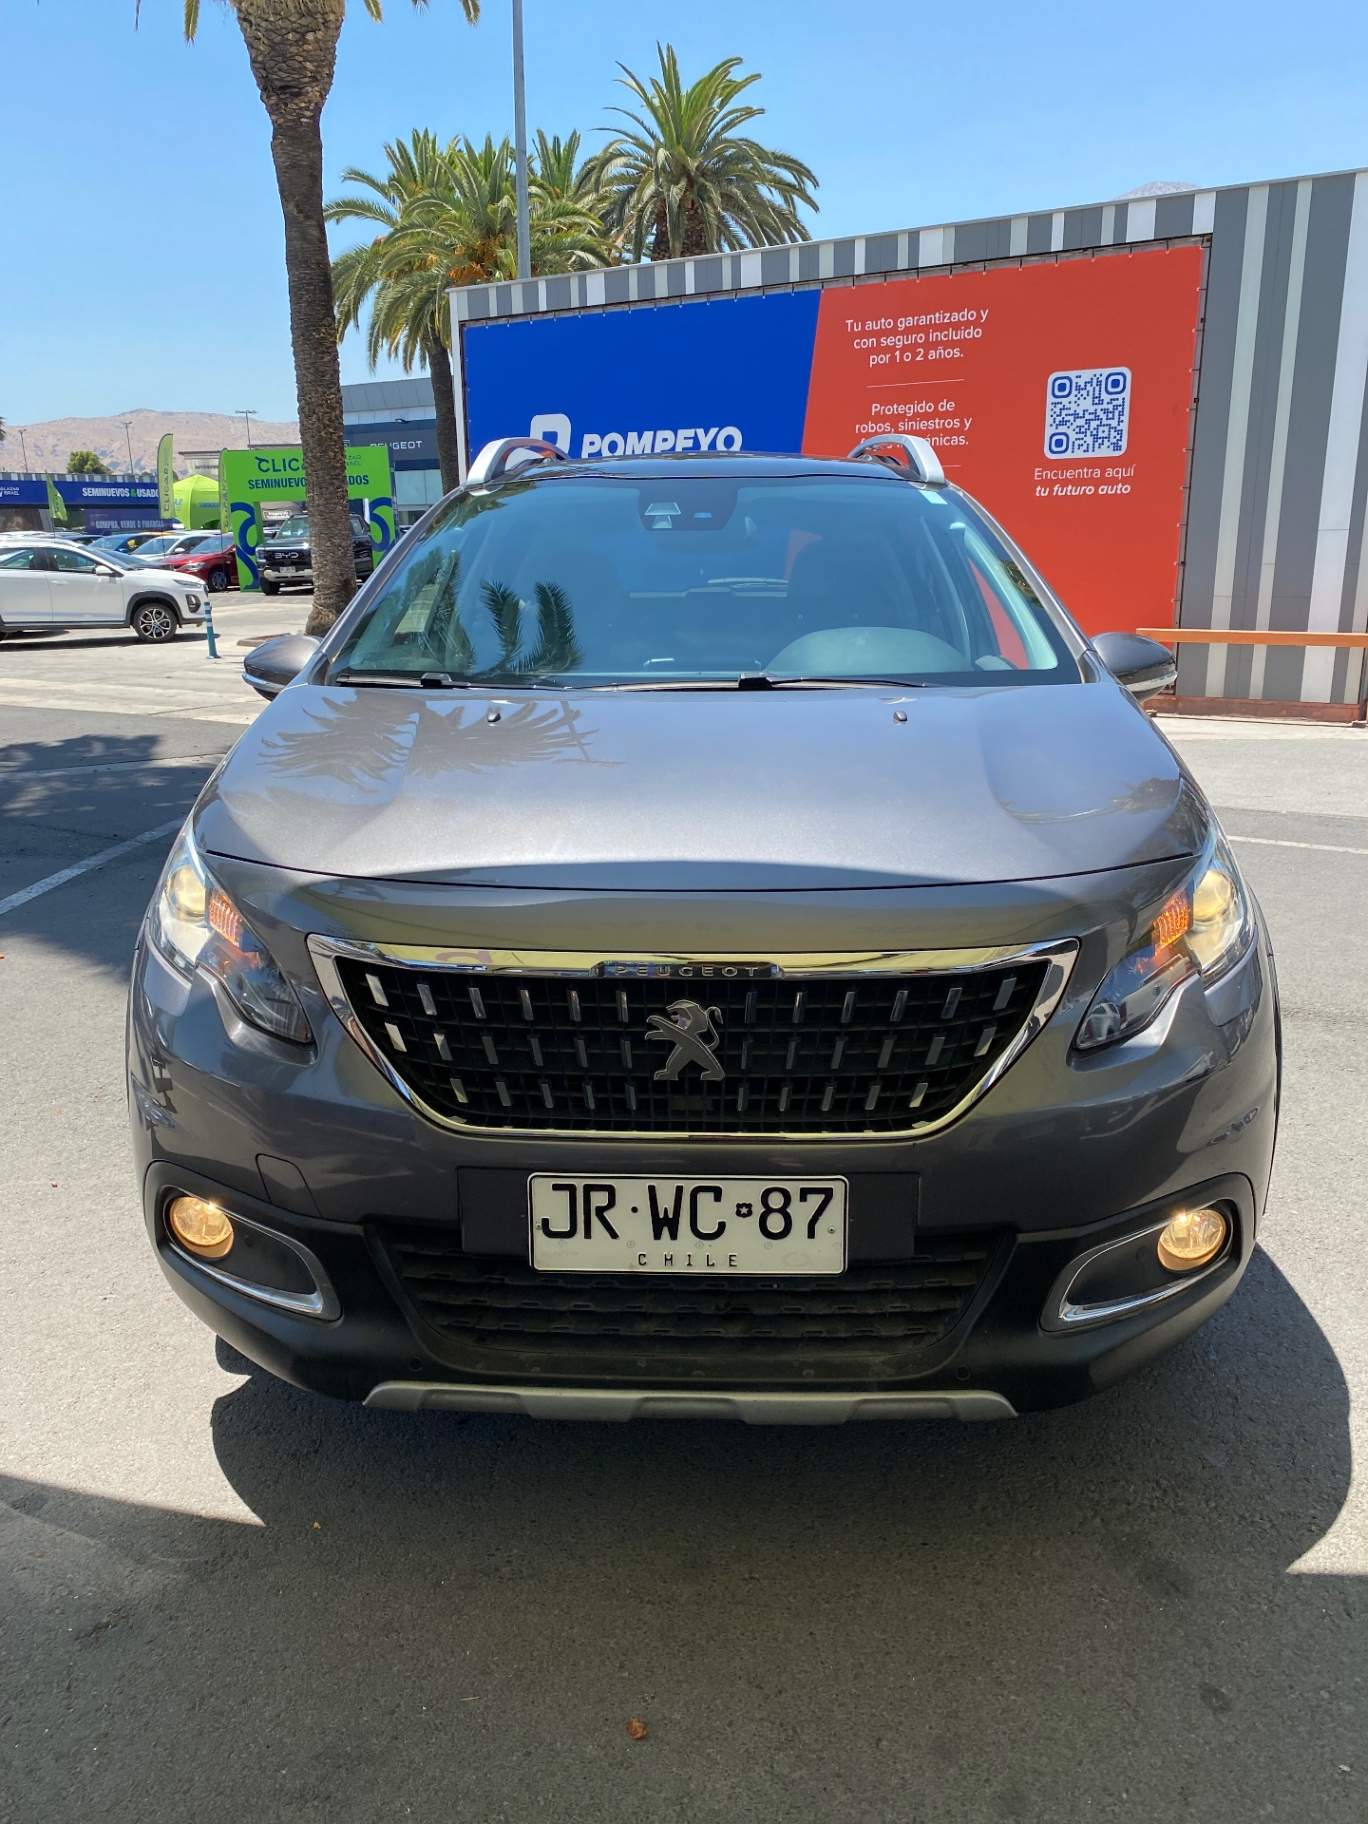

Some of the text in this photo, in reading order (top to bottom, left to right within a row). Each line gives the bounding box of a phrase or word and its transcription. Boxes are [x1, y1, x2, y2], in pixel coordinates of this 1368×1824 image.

[845, 308, 989, 332] Tu auto garantizado y
[853, 326, 982, 349] con seguro incluido
[869, 346, 964, 368] por 1 o 2 años.
[871, 399, 955, 416] Protegido de
[855, 417, 973, 433] robos, siniestros y
[581, 426, 743, 459] POMPEYO
[255, 456, 306, 473] CLIC
[1034, 464, 1136, 480] Encuentra aquí
[248, 474, 369, 490] SEMINUEVO DOS
[1035, 483, 1131, 496] tu futuro auto
[82, 487, 129, 497] SEMINUEVOS
[615, 965, 759, 977] PEUGEOT
[637, 1252, 739, 1268] CHILE
